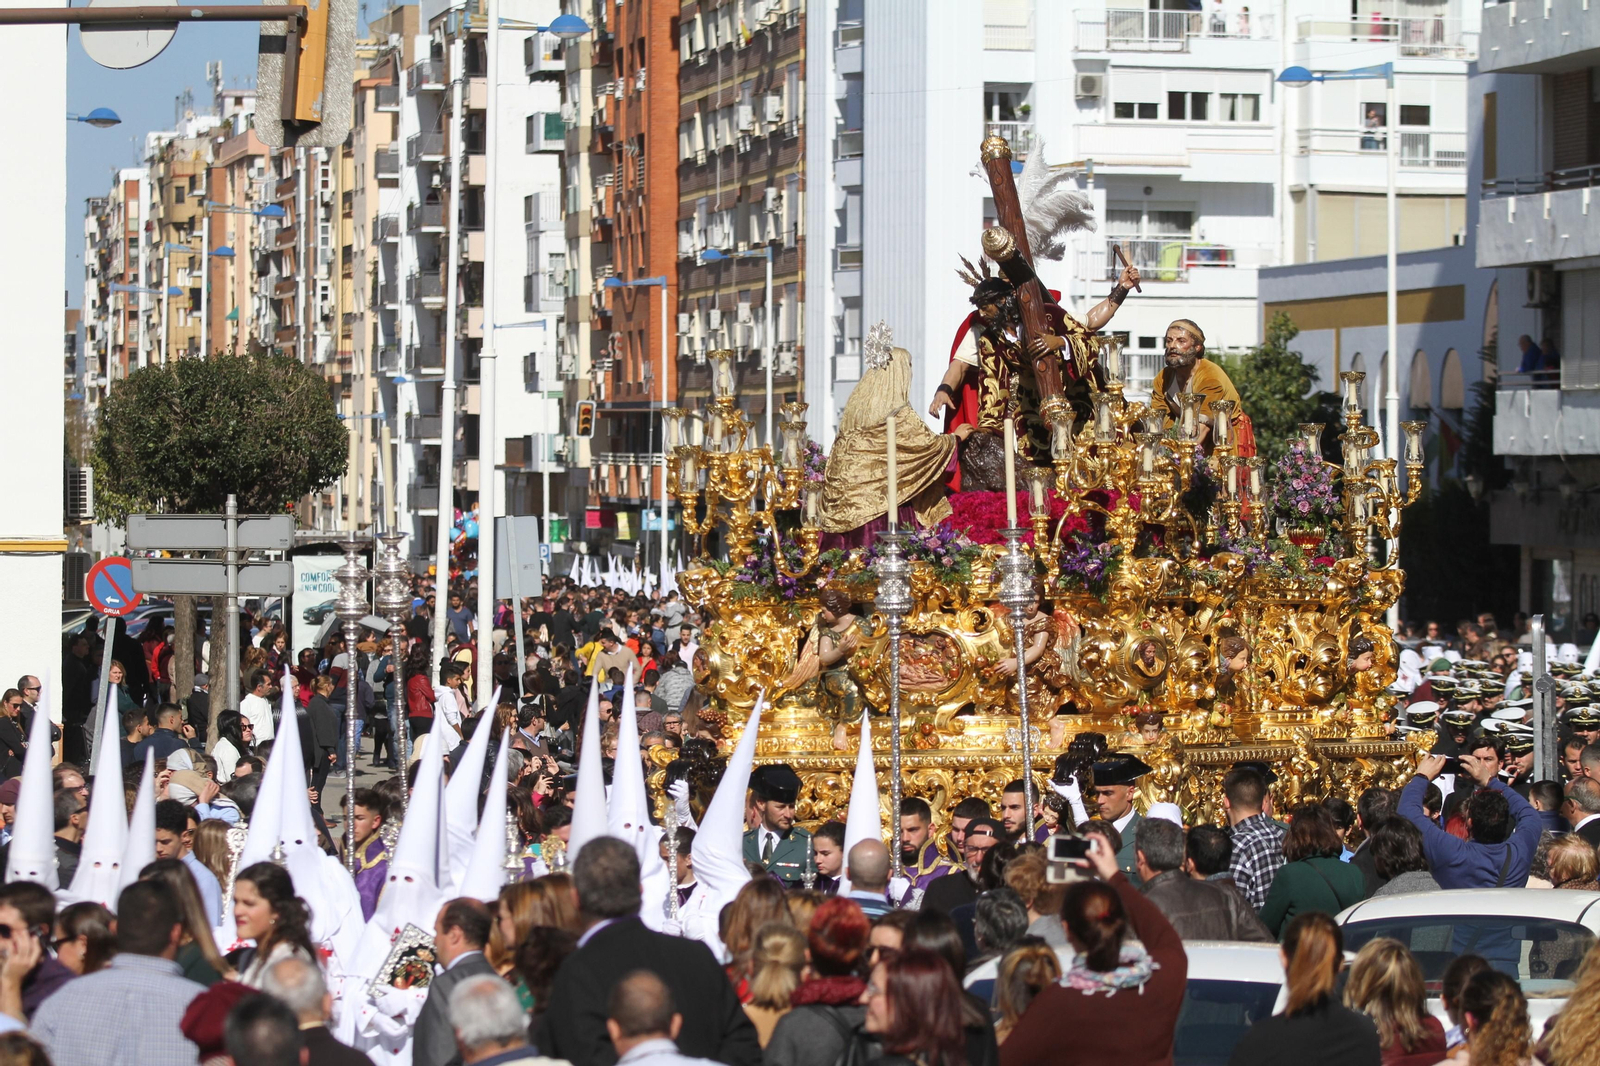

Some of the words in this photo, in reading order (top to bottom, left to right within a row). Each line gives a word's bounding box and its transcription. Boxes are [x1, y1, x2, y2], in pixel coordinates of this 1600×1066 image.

[541, 546, 548, 557] P
[300, 570, 336, 583] COMFOR
[305, 583, 317, 592] NEW
[103, 607, 121, 615] GRUA
